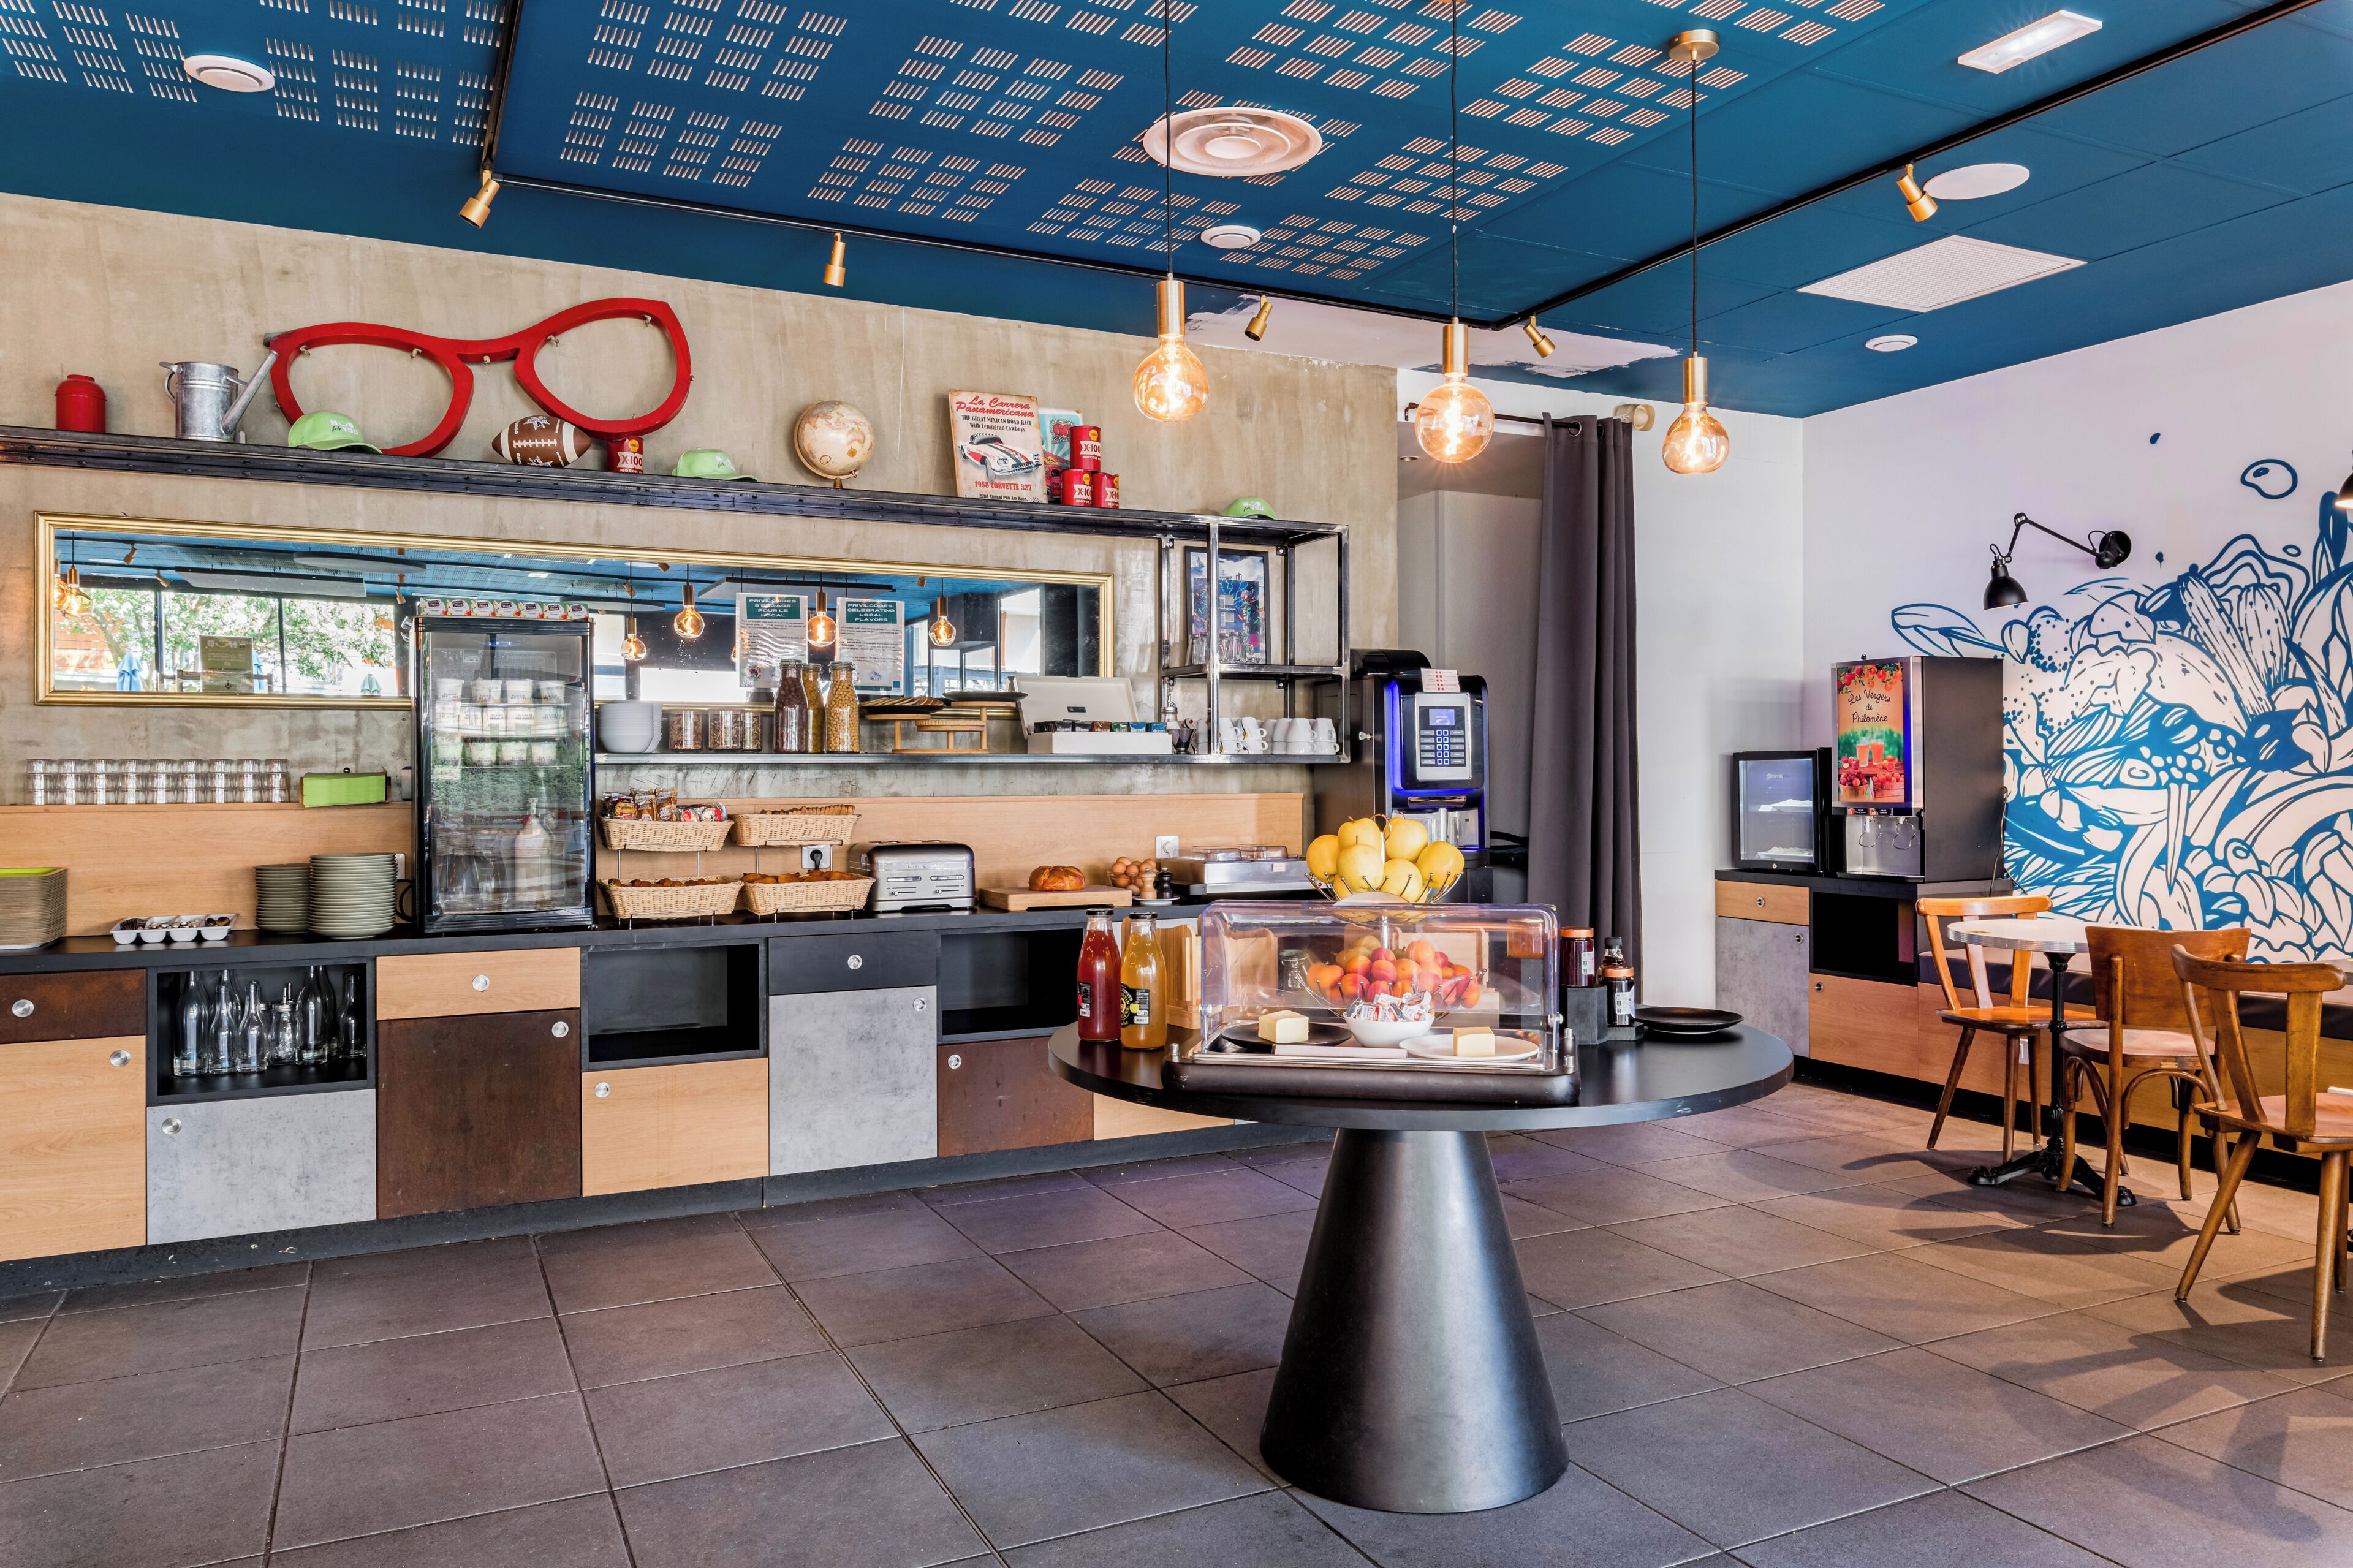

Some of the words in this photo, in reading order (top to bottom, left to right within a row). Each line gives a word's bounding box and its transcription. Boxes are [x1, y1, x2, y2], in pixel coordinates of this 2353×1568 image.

[968, 395, 985, 406] La
[989, 397, 1030, 409] Carrera
[955, 401, 1034, 418] Panamericana
[621, 455, 643, 466] X-100
[991, 482, 1019, 490] CORVETTE
[1848, 694, 1862, 705] Les
[1863, 689, 1890, 703] Vergers
[1852, 711, 1888, 723] Philomène
